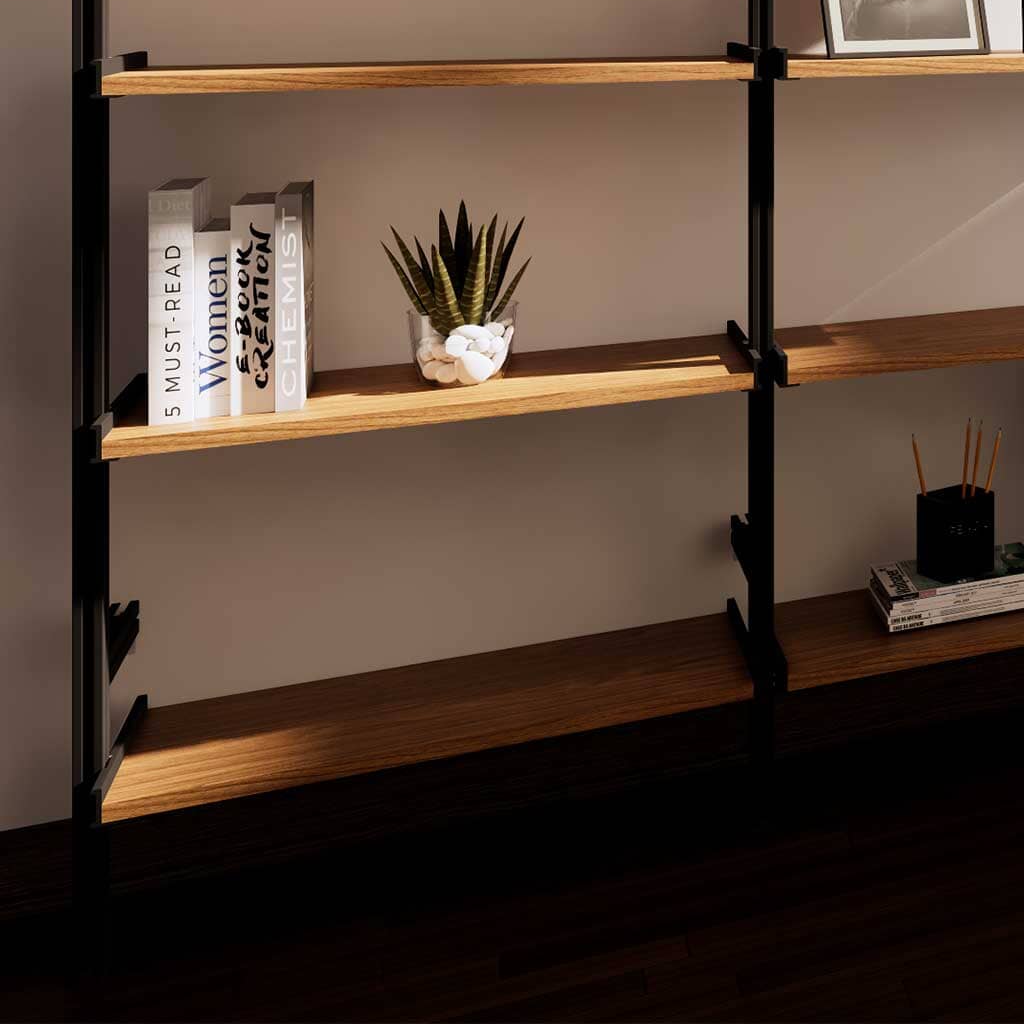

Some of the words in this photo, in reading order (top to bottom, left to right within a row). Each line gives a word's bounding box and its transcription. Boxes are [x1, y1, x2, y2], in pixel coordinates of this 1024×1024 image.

[165, 244, 181, 392] MUST-READ
[199, 254, 228, 395] Women
[235, 240, 253, 374] E-BOOK
[250, 222, 274, 389] CREATION
[282, 208, 297, 397] CHEMIST
[165, 406, 181, 417] 5
